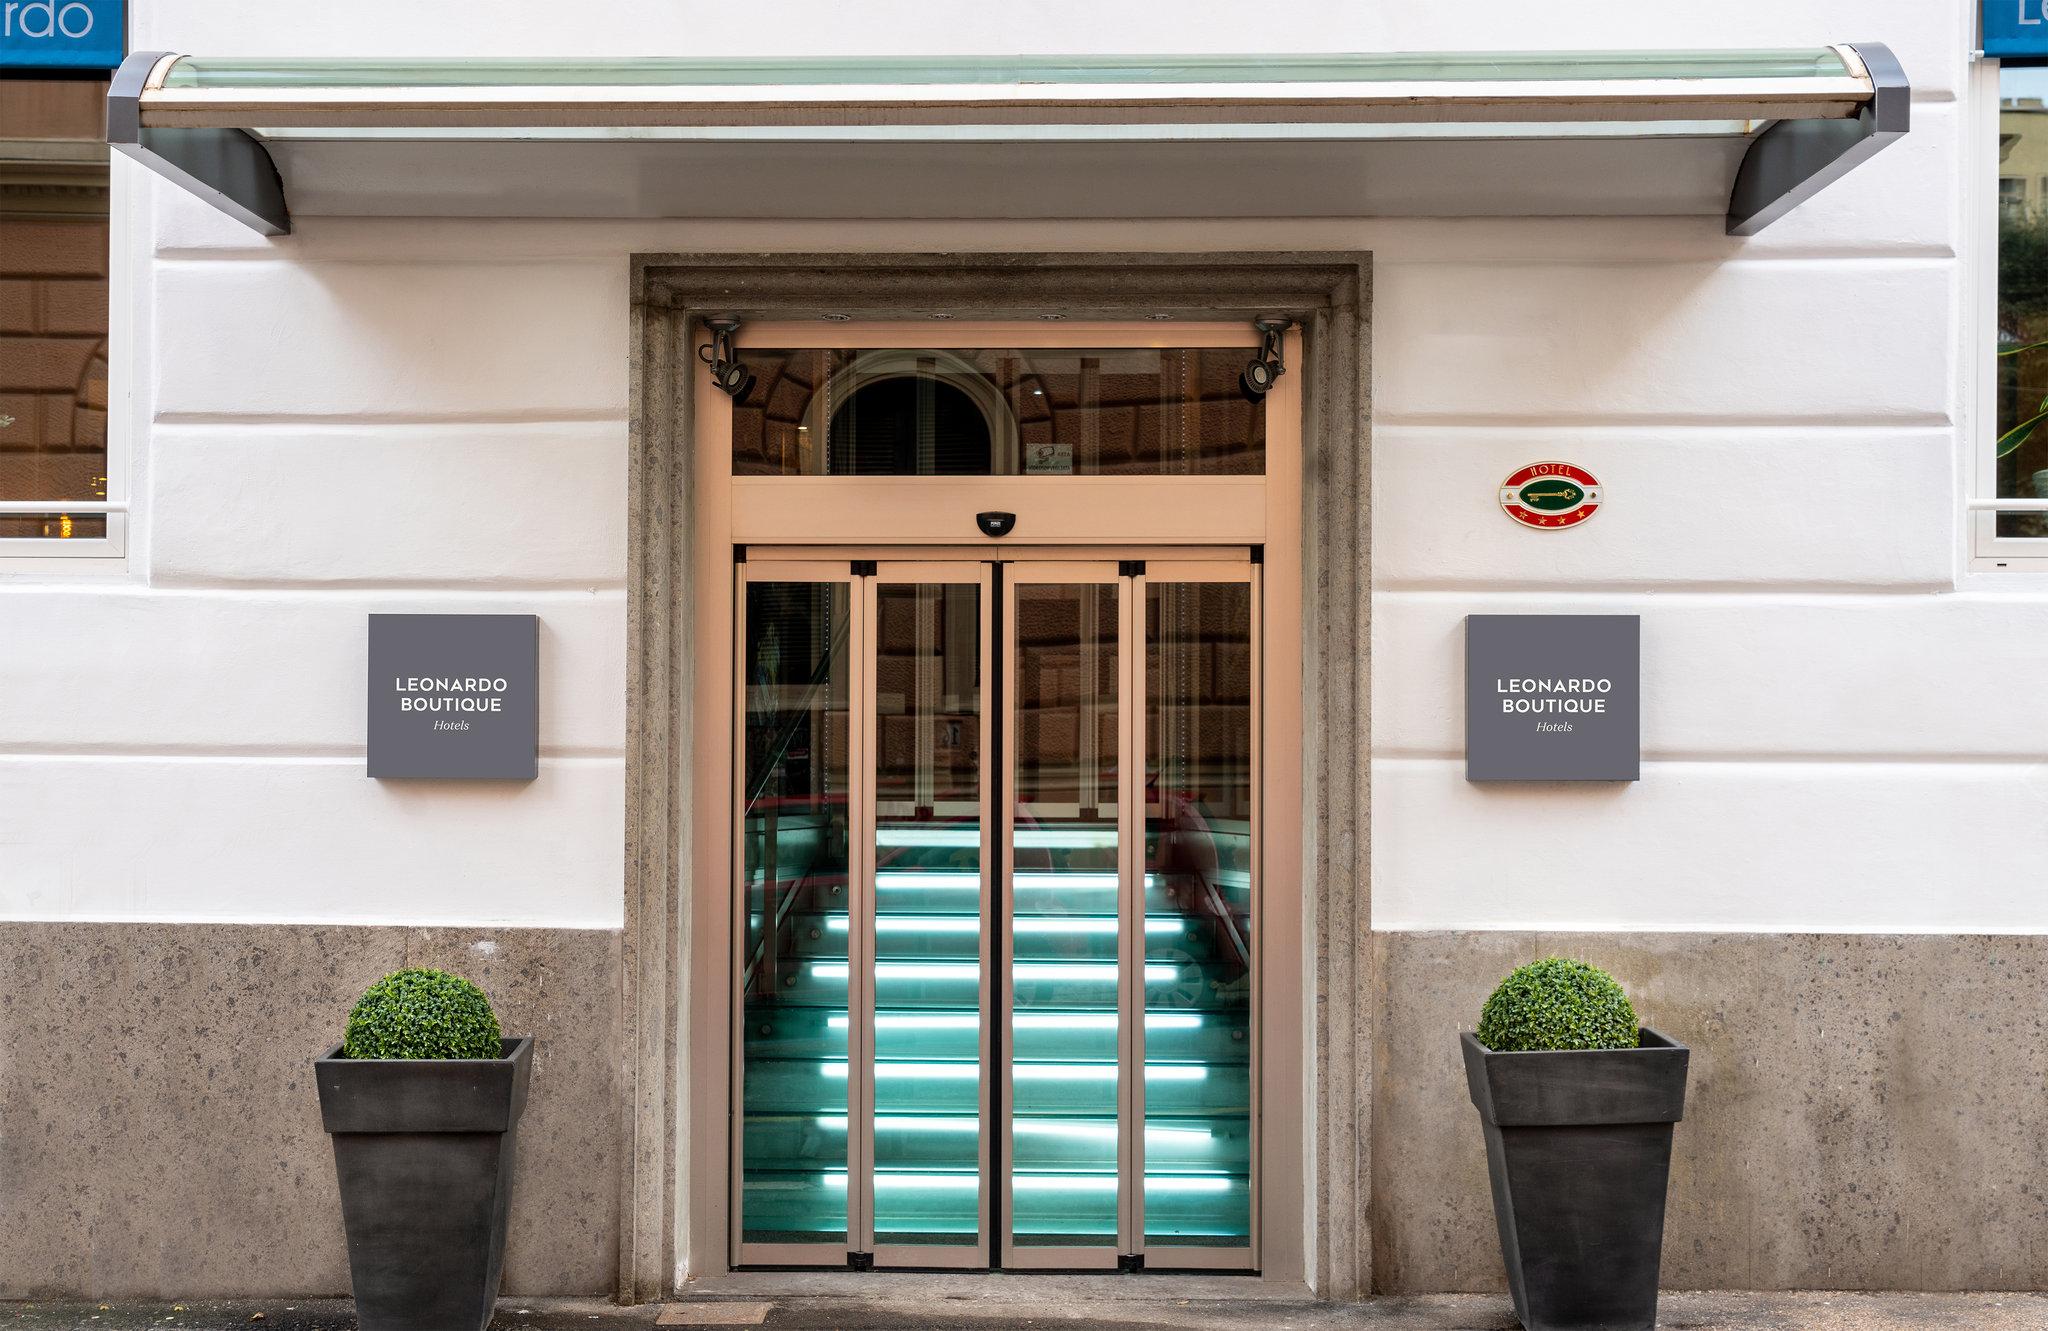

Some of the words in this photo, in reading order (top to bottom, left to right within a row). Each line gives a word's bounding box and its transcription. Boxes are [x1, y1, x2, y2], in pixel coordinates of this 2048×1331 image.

[5, 0, 94, 38] rdo
[1529, 464, 1571, 477] HOTEL
[396, 677, 508, 692] LEONARDO
[1497, 678, 1612, 693] LEONARDO
[401, 697, 502, 712] BOUTIQUE
[1502, 698, 1606, 713] BOUTIQUE
[433, 720, 470, 731] Hotels
[1536, 721, 1573, 732] Hotels
